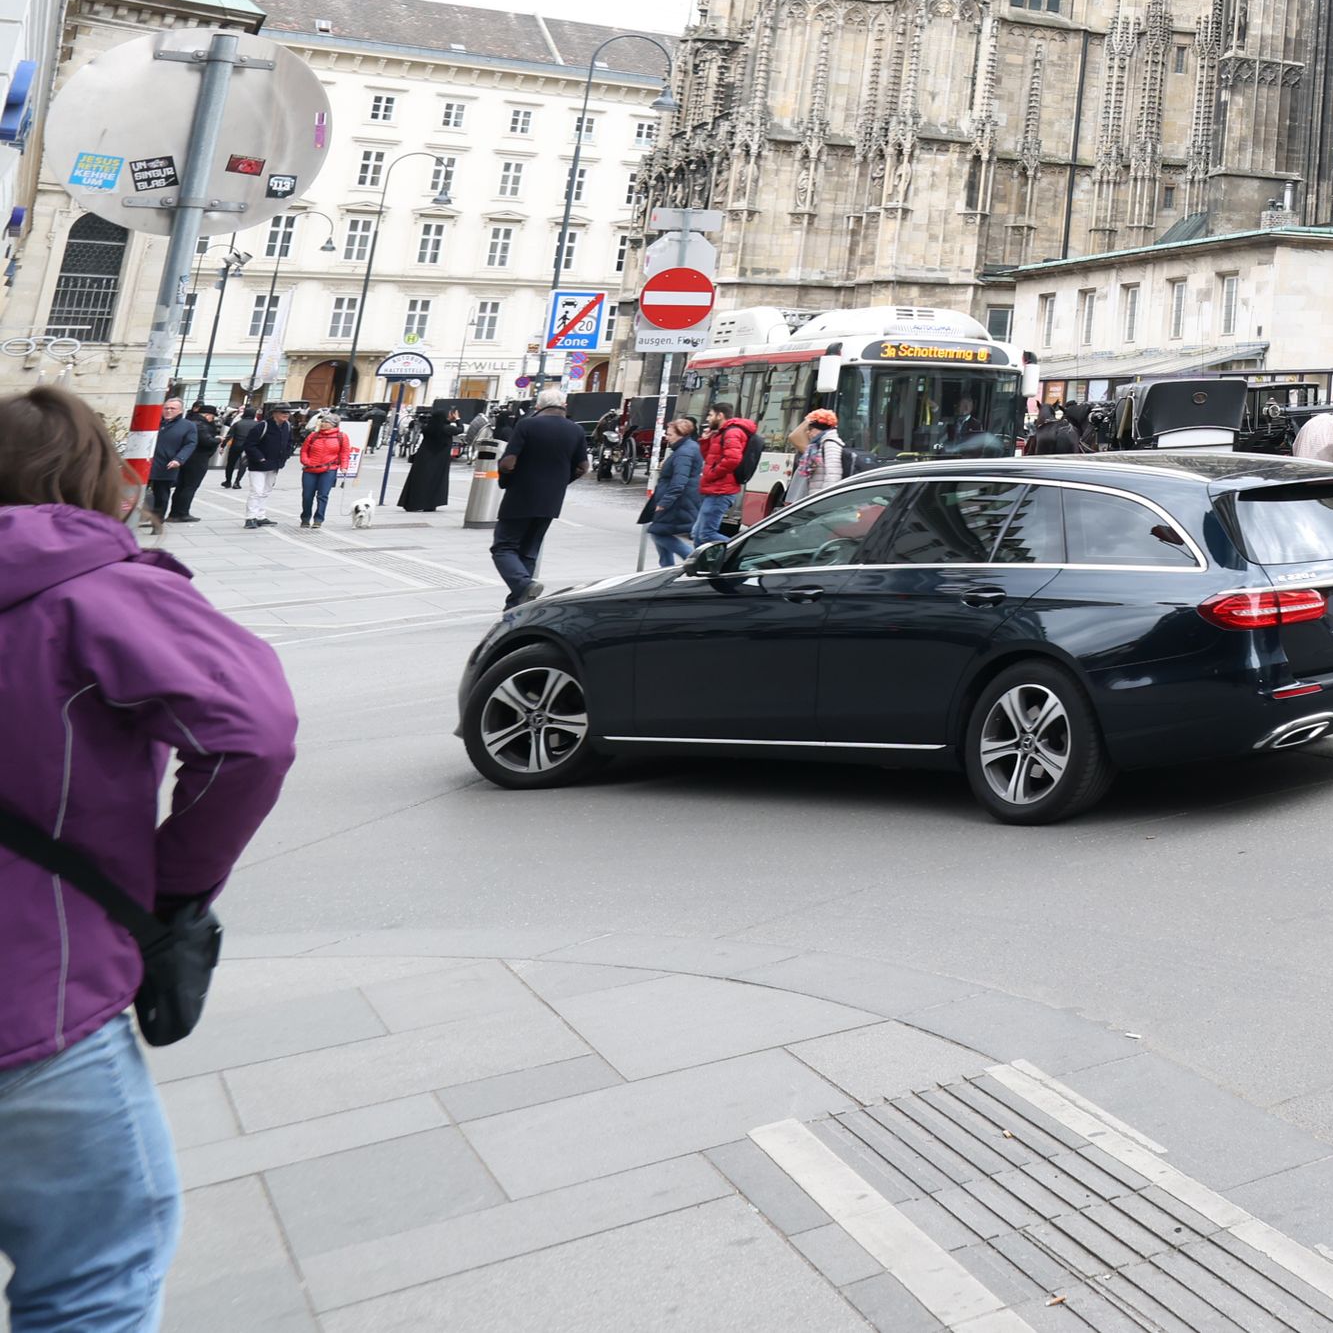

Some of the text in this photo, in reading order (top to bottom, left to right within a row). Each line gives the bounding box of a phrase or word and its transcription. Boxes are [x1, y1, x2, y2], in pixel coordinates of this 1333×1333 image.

[80, 155, 120, 166] JESUS
[73, 170, 116, 180] KEHRE
[82, 177, 102, 186] UM
[578, 320, 593, 332] 20
[556, 337, 589, 347] Zone
[638, 336, 705, 347] ausgen. Fiker
[898, 344, 973, 361] Schottenring
[443, 361, 517, 371] FREYWILLE
